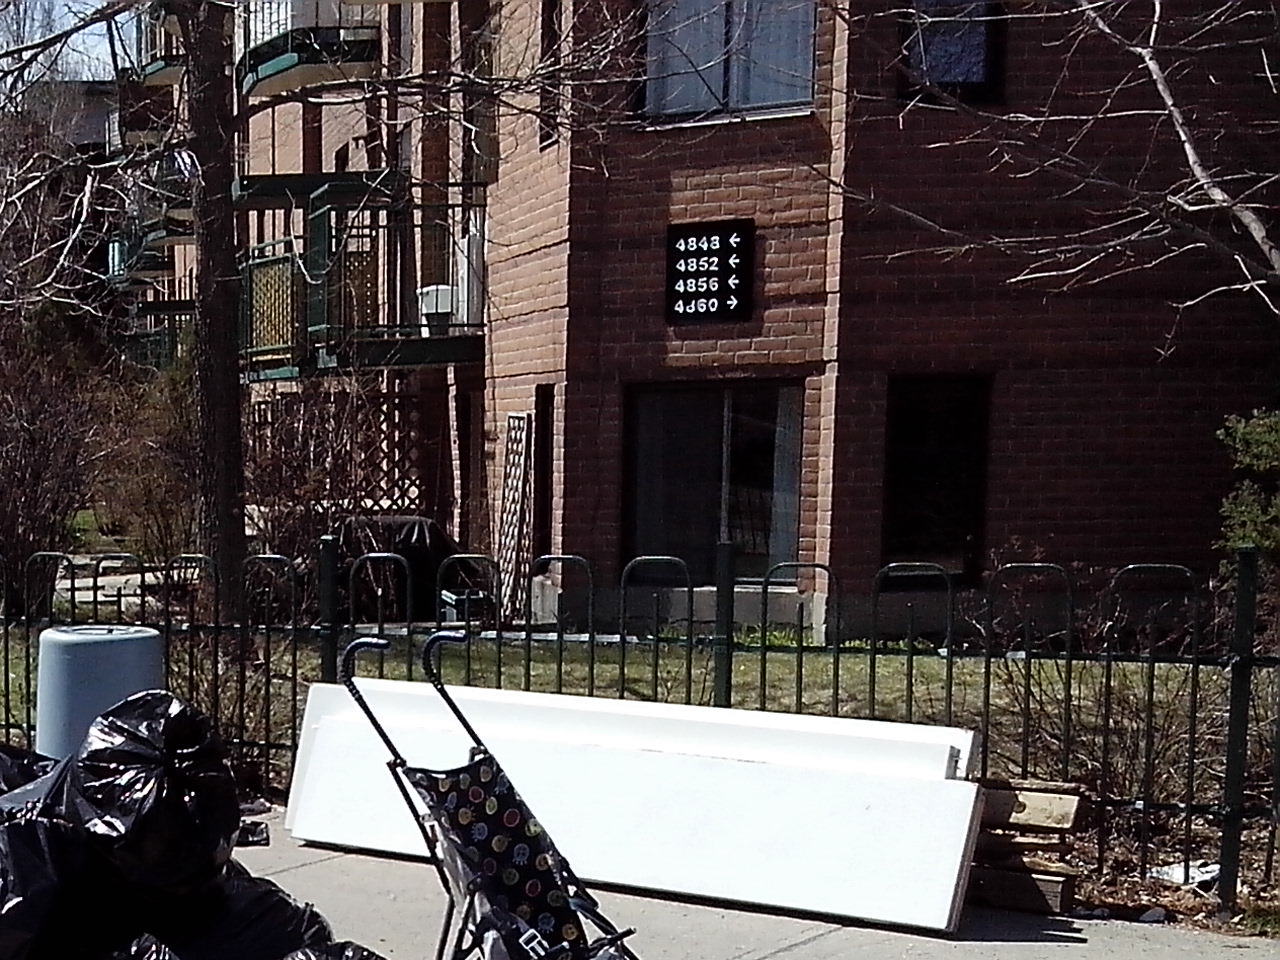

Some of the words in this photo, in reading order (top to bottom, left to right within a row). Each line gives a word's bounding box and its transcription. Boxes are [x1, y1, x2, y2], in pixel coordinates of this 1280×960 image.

[675, 235, 720, 252] 4848
[675, 256, 719, 272] 4852
[674, 276, 719, 293] 4856
